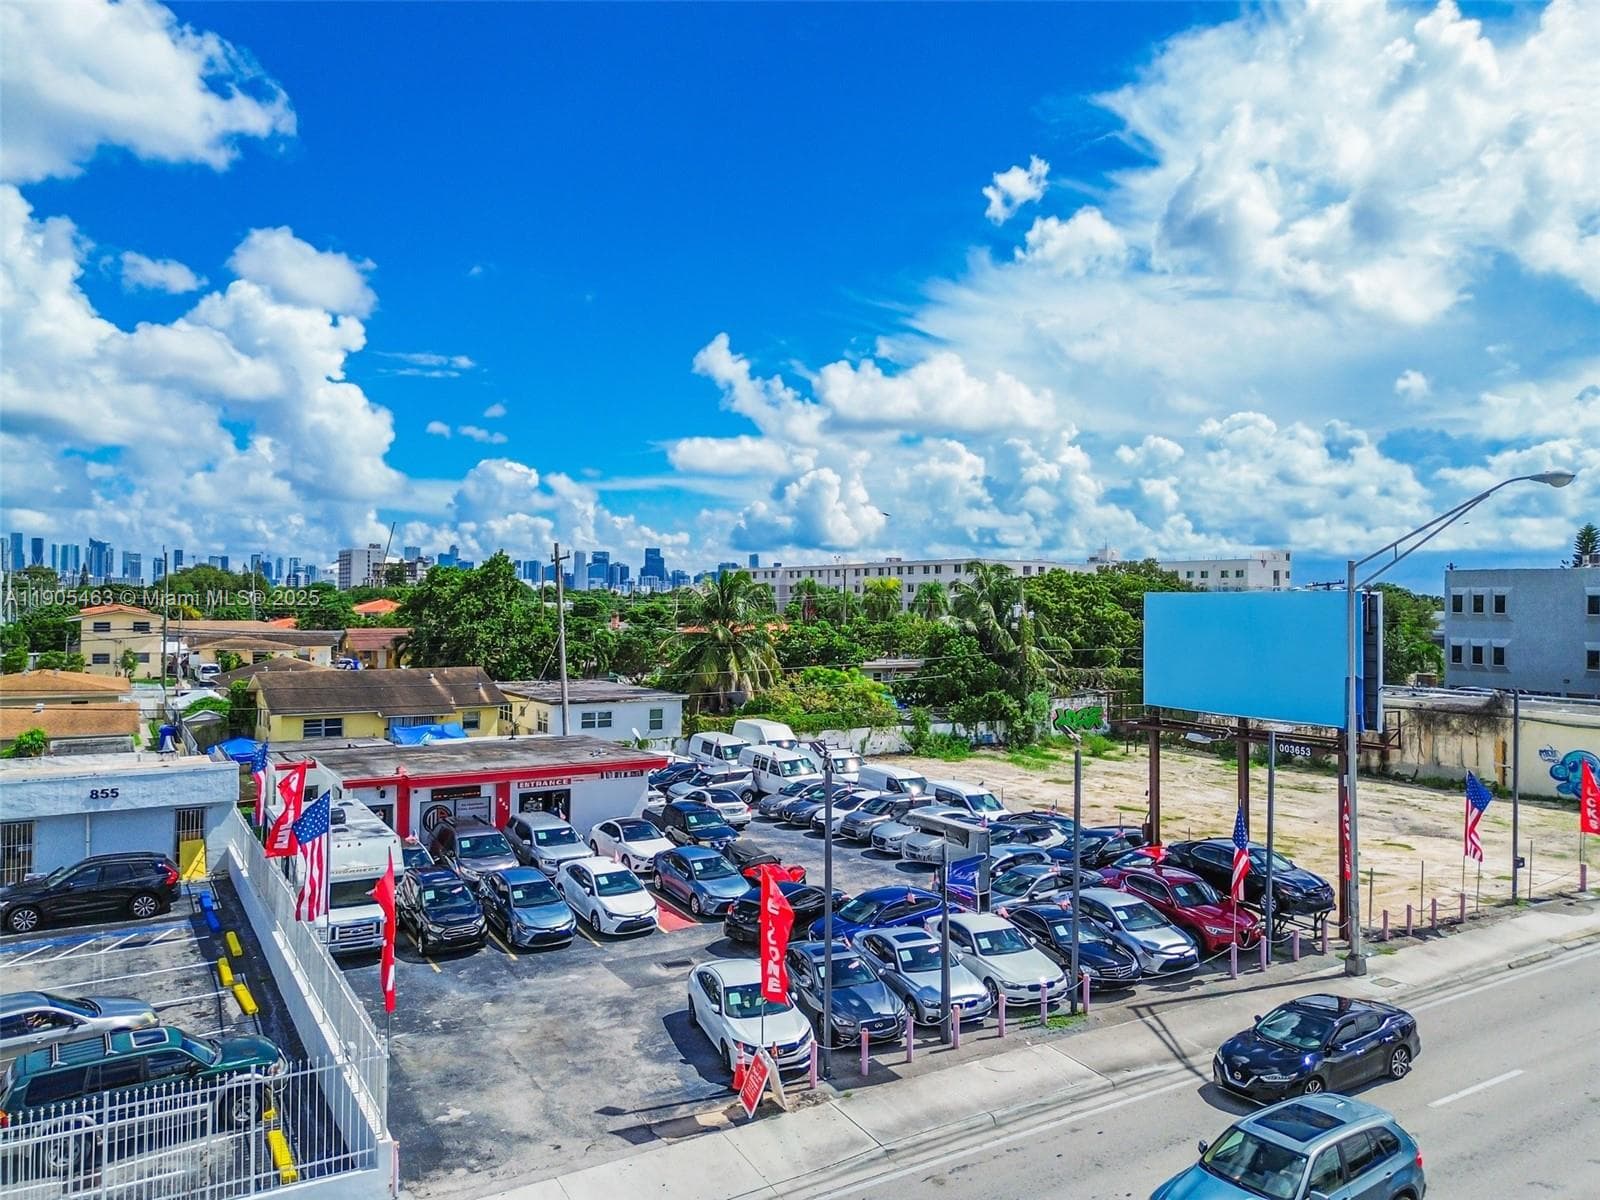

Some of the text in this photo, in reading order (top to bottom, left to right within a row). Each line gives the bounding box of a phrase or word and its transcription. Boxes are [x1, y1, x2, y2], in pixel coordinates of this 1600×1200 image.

[1279, 743, 1311, 757] 003653
[519, 779, 569, 789] ENTRANCE
[90, 787, 119, 800] 855
